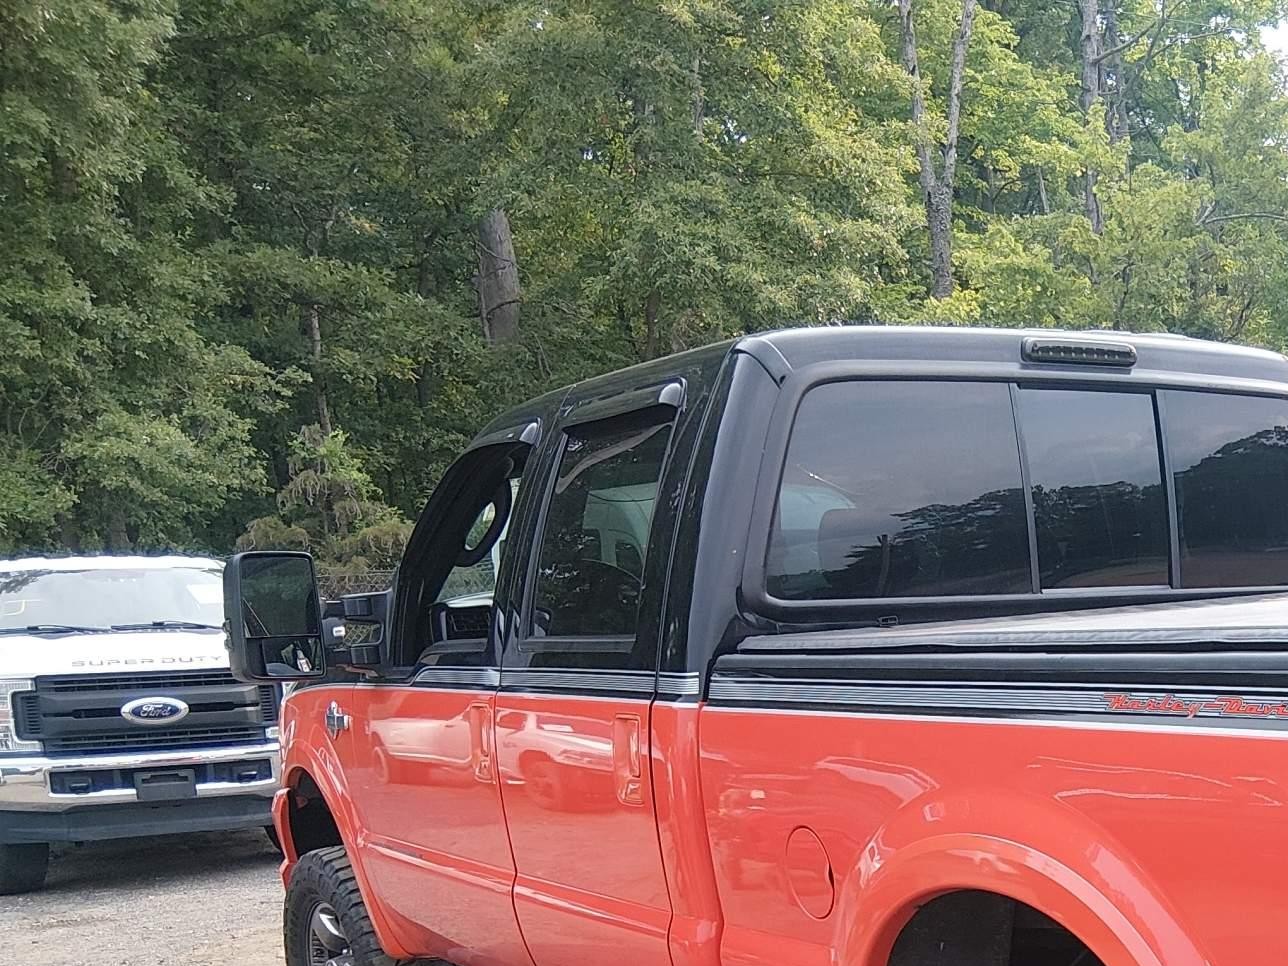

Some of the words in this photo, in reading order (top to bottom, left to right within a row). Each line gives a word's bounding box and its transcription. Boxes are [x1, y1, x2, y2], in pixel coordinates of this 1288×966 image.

[71, 657, 155, 668] SUPER
[161, 655, 223, 665] DUTY
[140, 703, 172, 718] Ford
